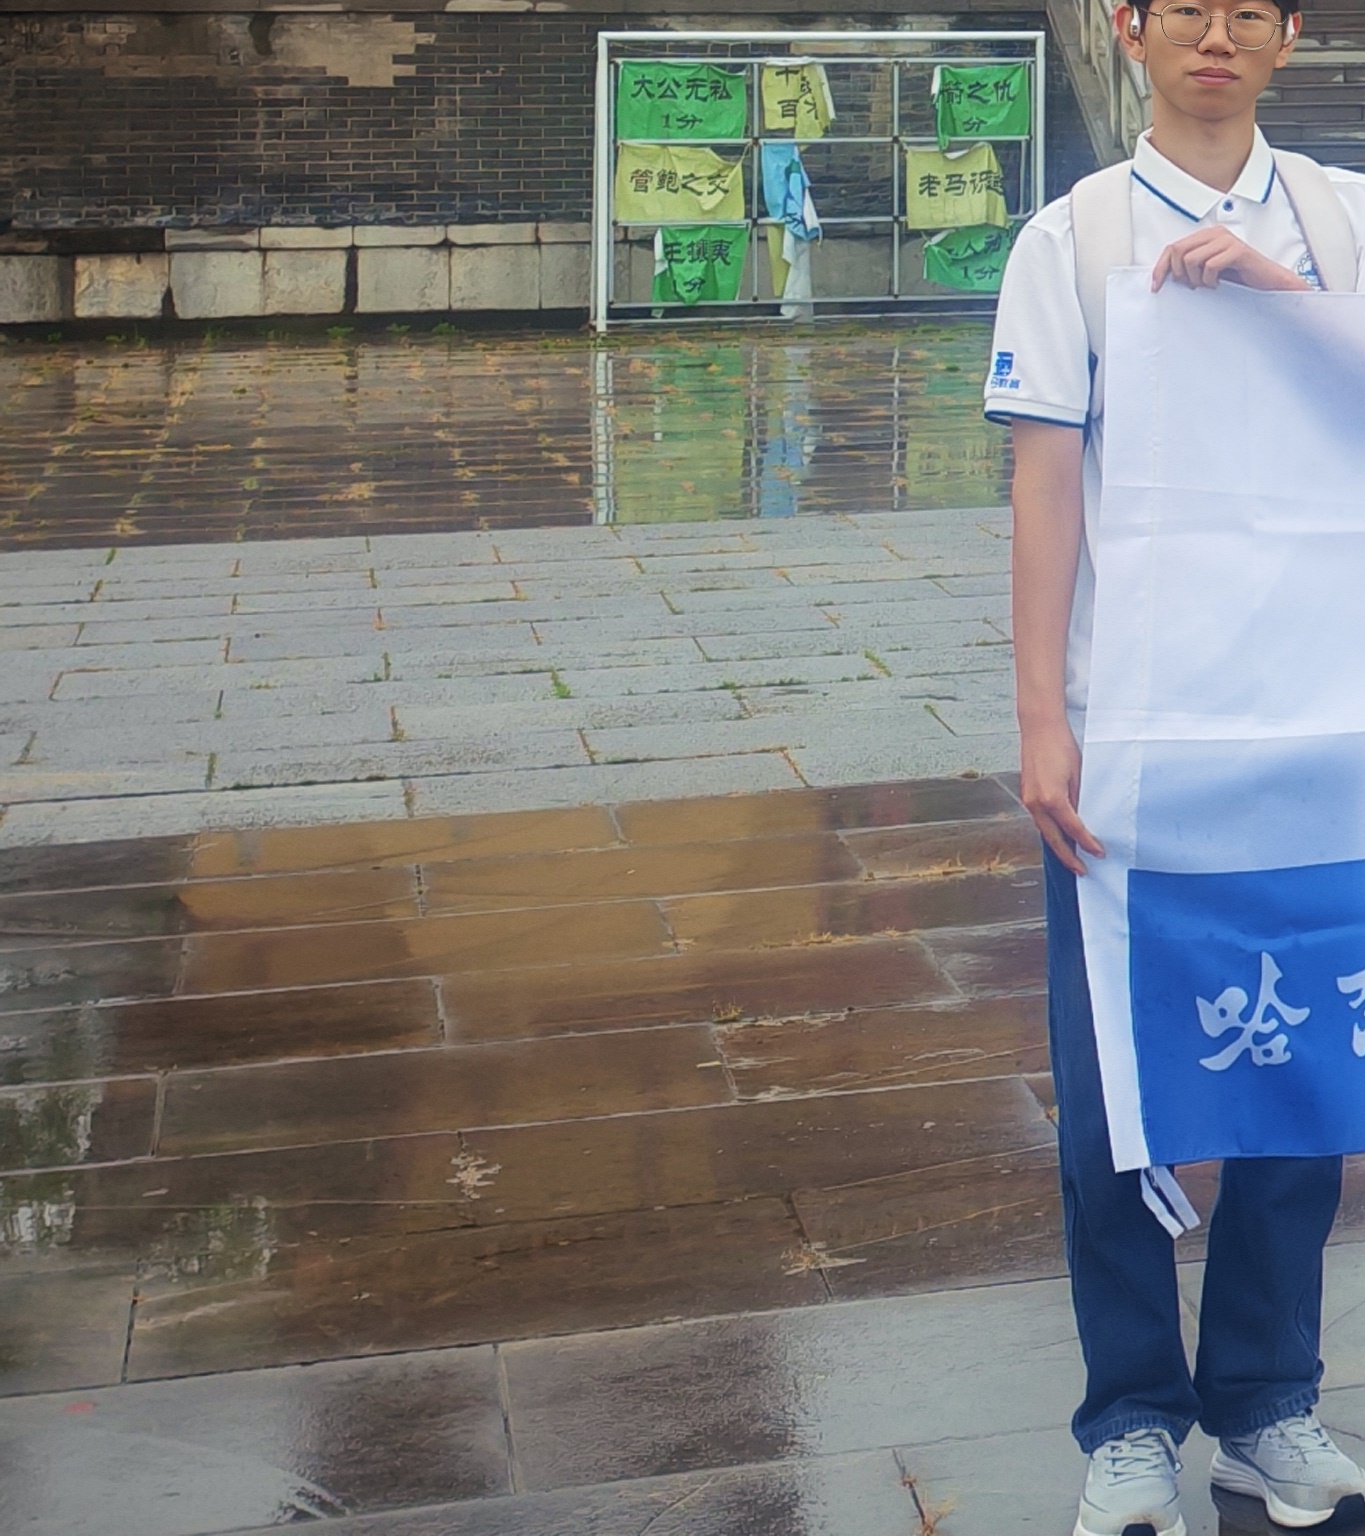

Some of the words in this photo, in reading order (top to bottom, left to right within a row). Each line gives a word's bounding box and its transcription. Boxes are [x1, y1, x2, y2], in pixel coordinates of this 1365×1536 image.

[630, 74, 734, 102] 大公无私
[661, 113, 704, 130] 1分
[629, 168, 731, 196] 管鲍之交
